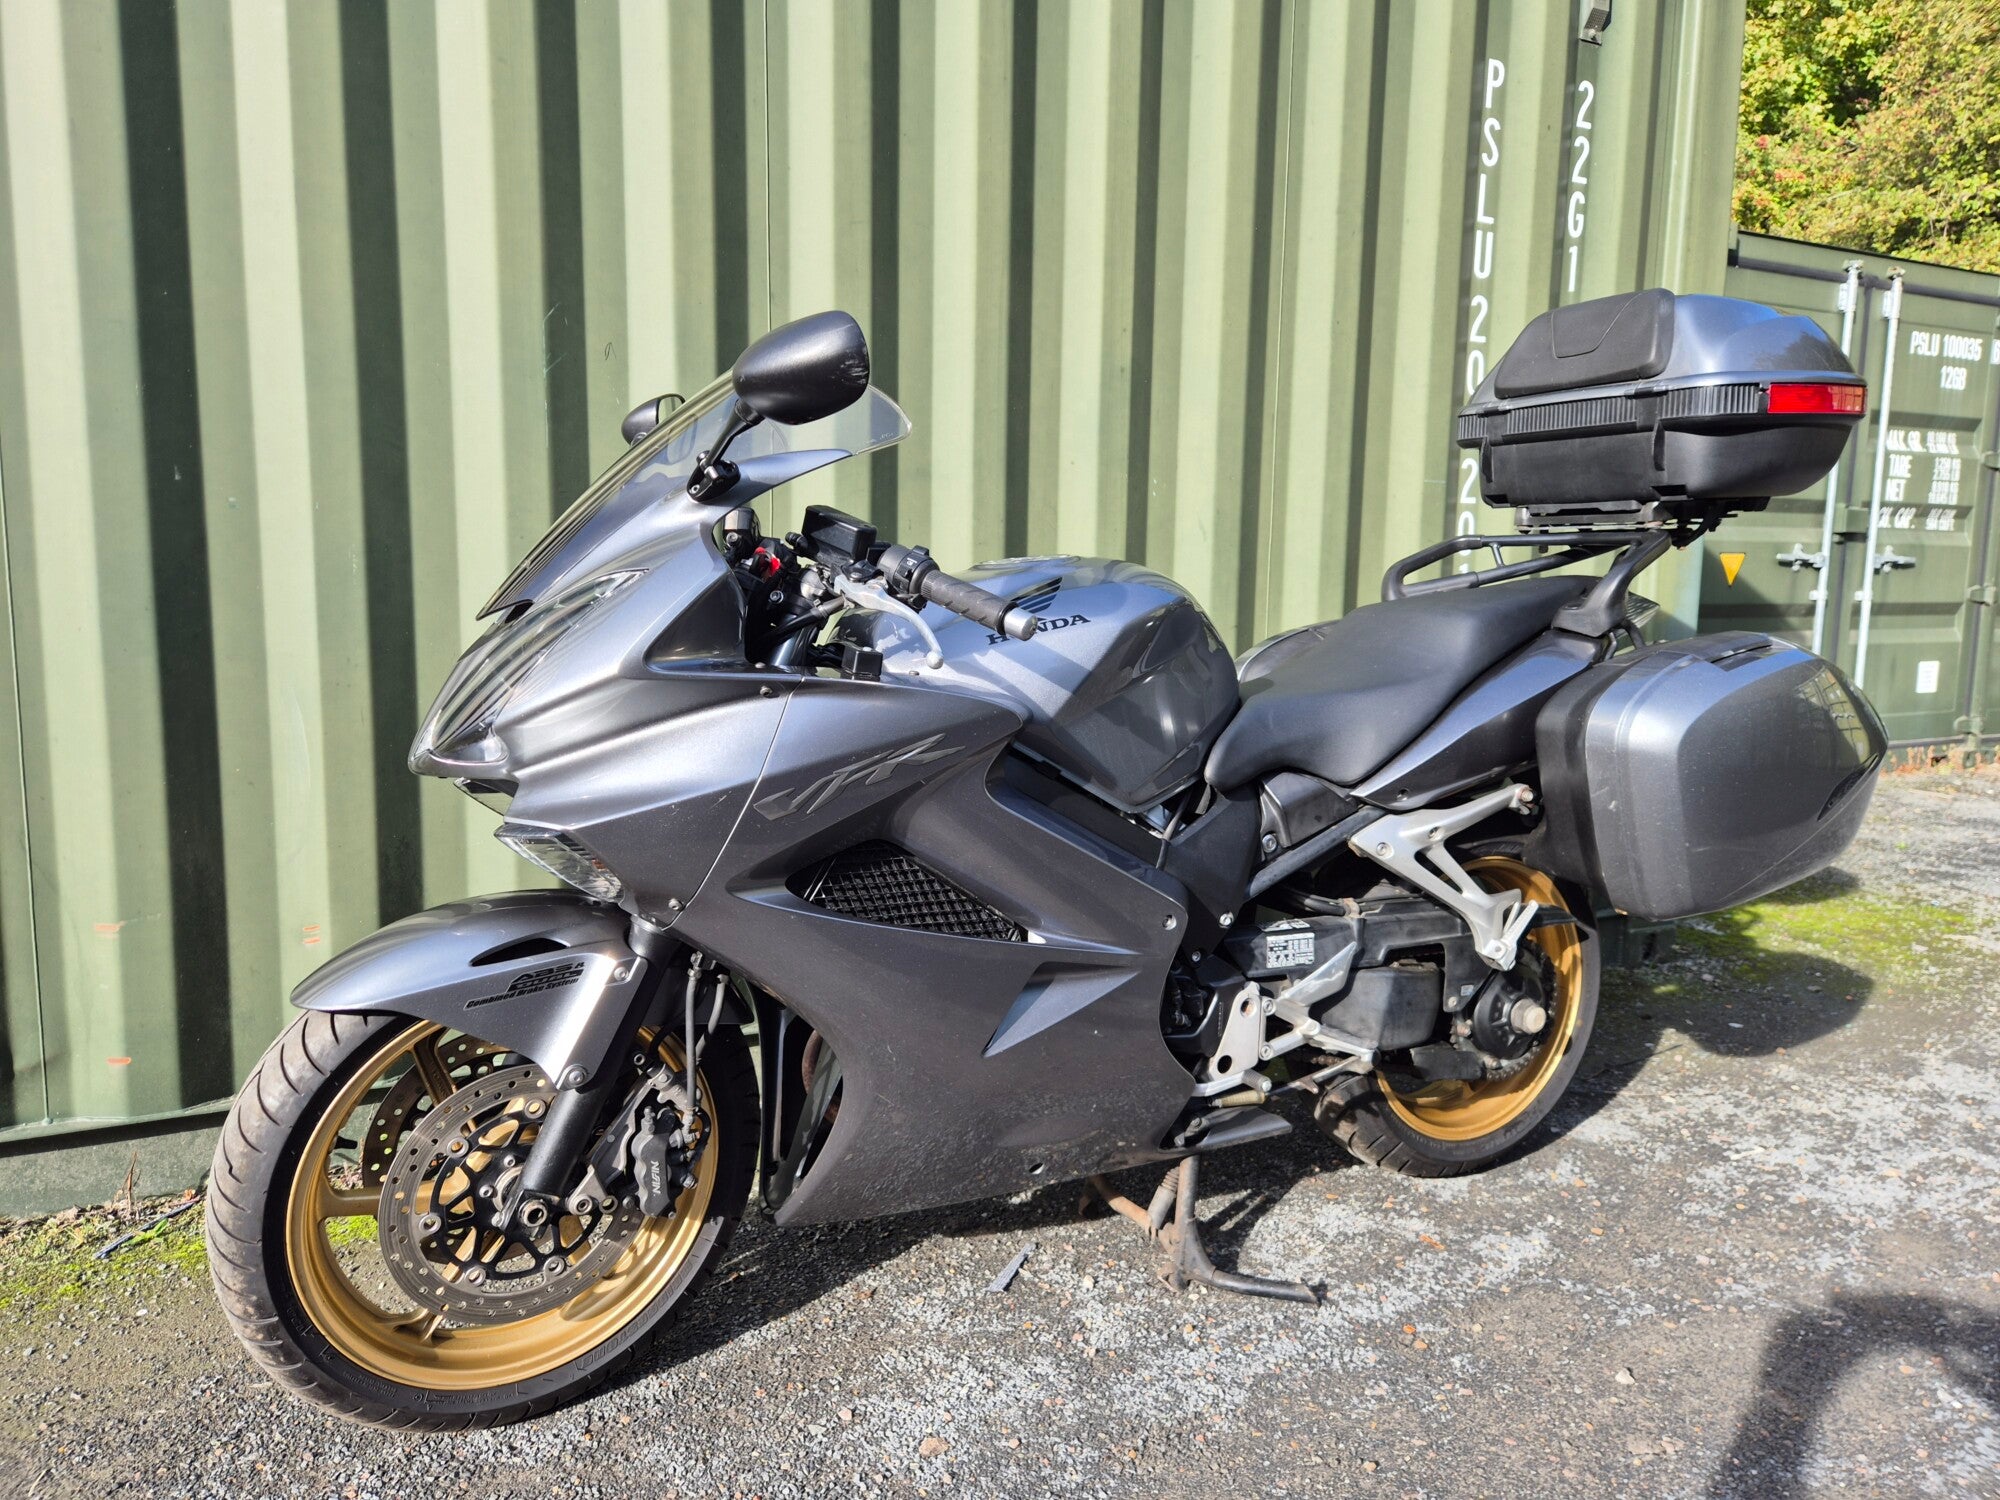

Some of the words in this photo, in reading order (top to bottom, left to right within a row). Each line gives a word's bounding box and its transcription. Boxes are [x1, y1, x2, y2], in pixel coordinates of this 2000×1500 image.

[1473, 57, 1506, 280] PSLU
[1567, 79, 1596, 293] 22G1
[1909, 330, 1941, 357] PSLU
[1943, 334, 1983, 361] 100035
[1888, 453, 1913, 478] TARE
[1884, 478, 1907, 502] NET
[985, 613, 1092, 646] HNDA
[511, 963, 574, 984] ABS
[465, 991, 516, 1009] Combined
[516, 986, 545, 998] Brake
[544, 977, 580, 991] System
